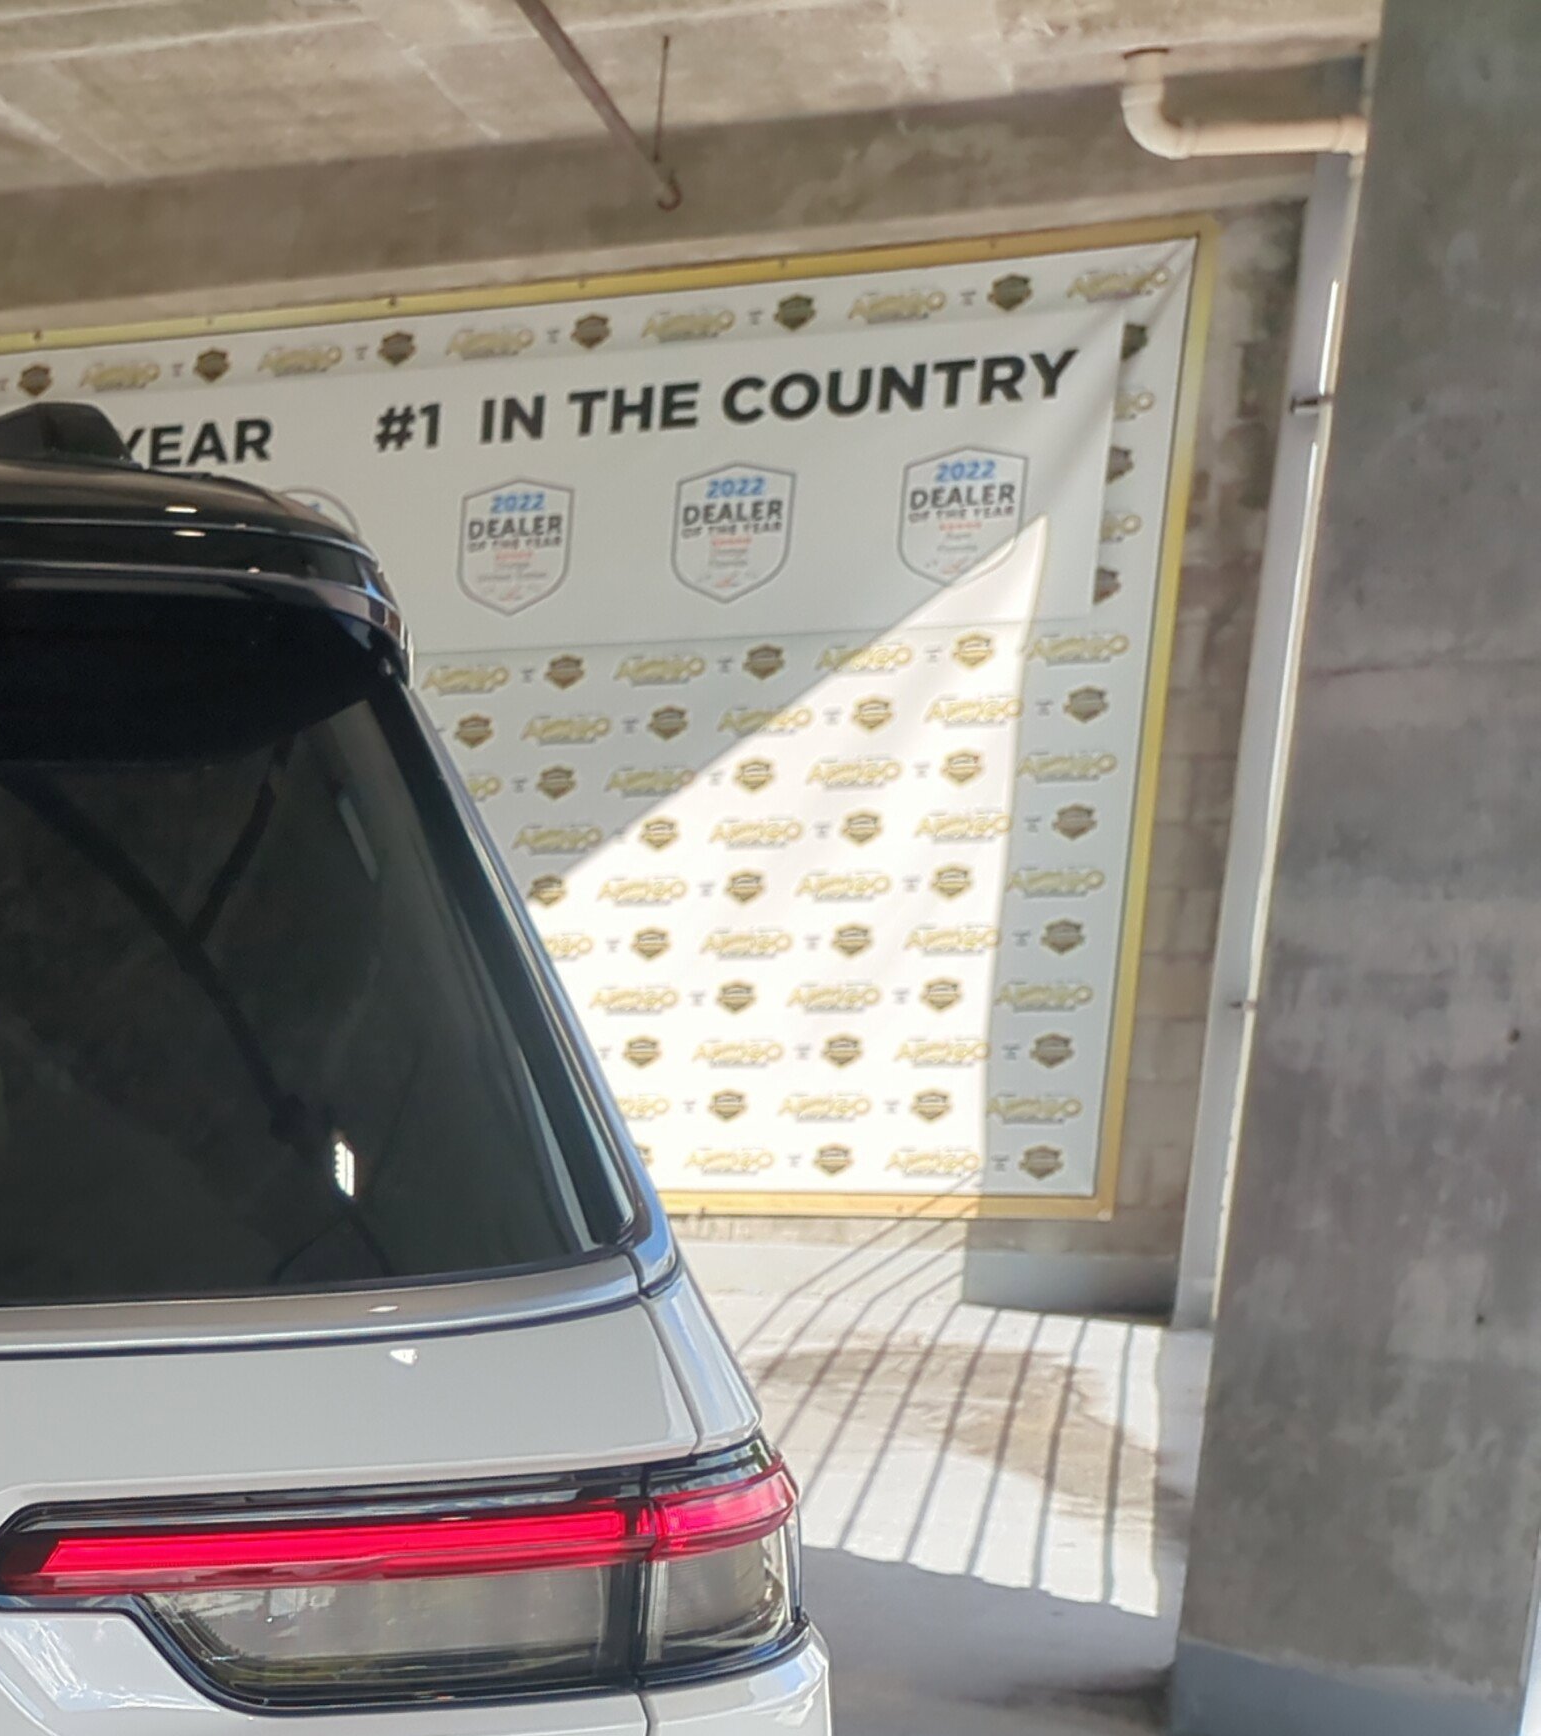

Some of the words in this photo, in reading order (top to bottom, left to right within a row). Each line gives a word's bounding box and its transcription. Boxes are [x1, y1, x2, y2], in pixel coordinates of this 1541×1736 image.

[375, 402, 441, 451] #1
[480, 395, 545, 444] IN
[568, 382, 700, 437] THE
[723, 349, 1078, 424] COUNTRY
[935, 460, 996, 483] 2022
[705, 476, 766, 499] 2022
[909, 483, 1015, 511] DEALER
[490, 491, 545, 514] 2022
[682, 500, 782, 527] DEALER
[468, 514, 562, 540] DEALER
